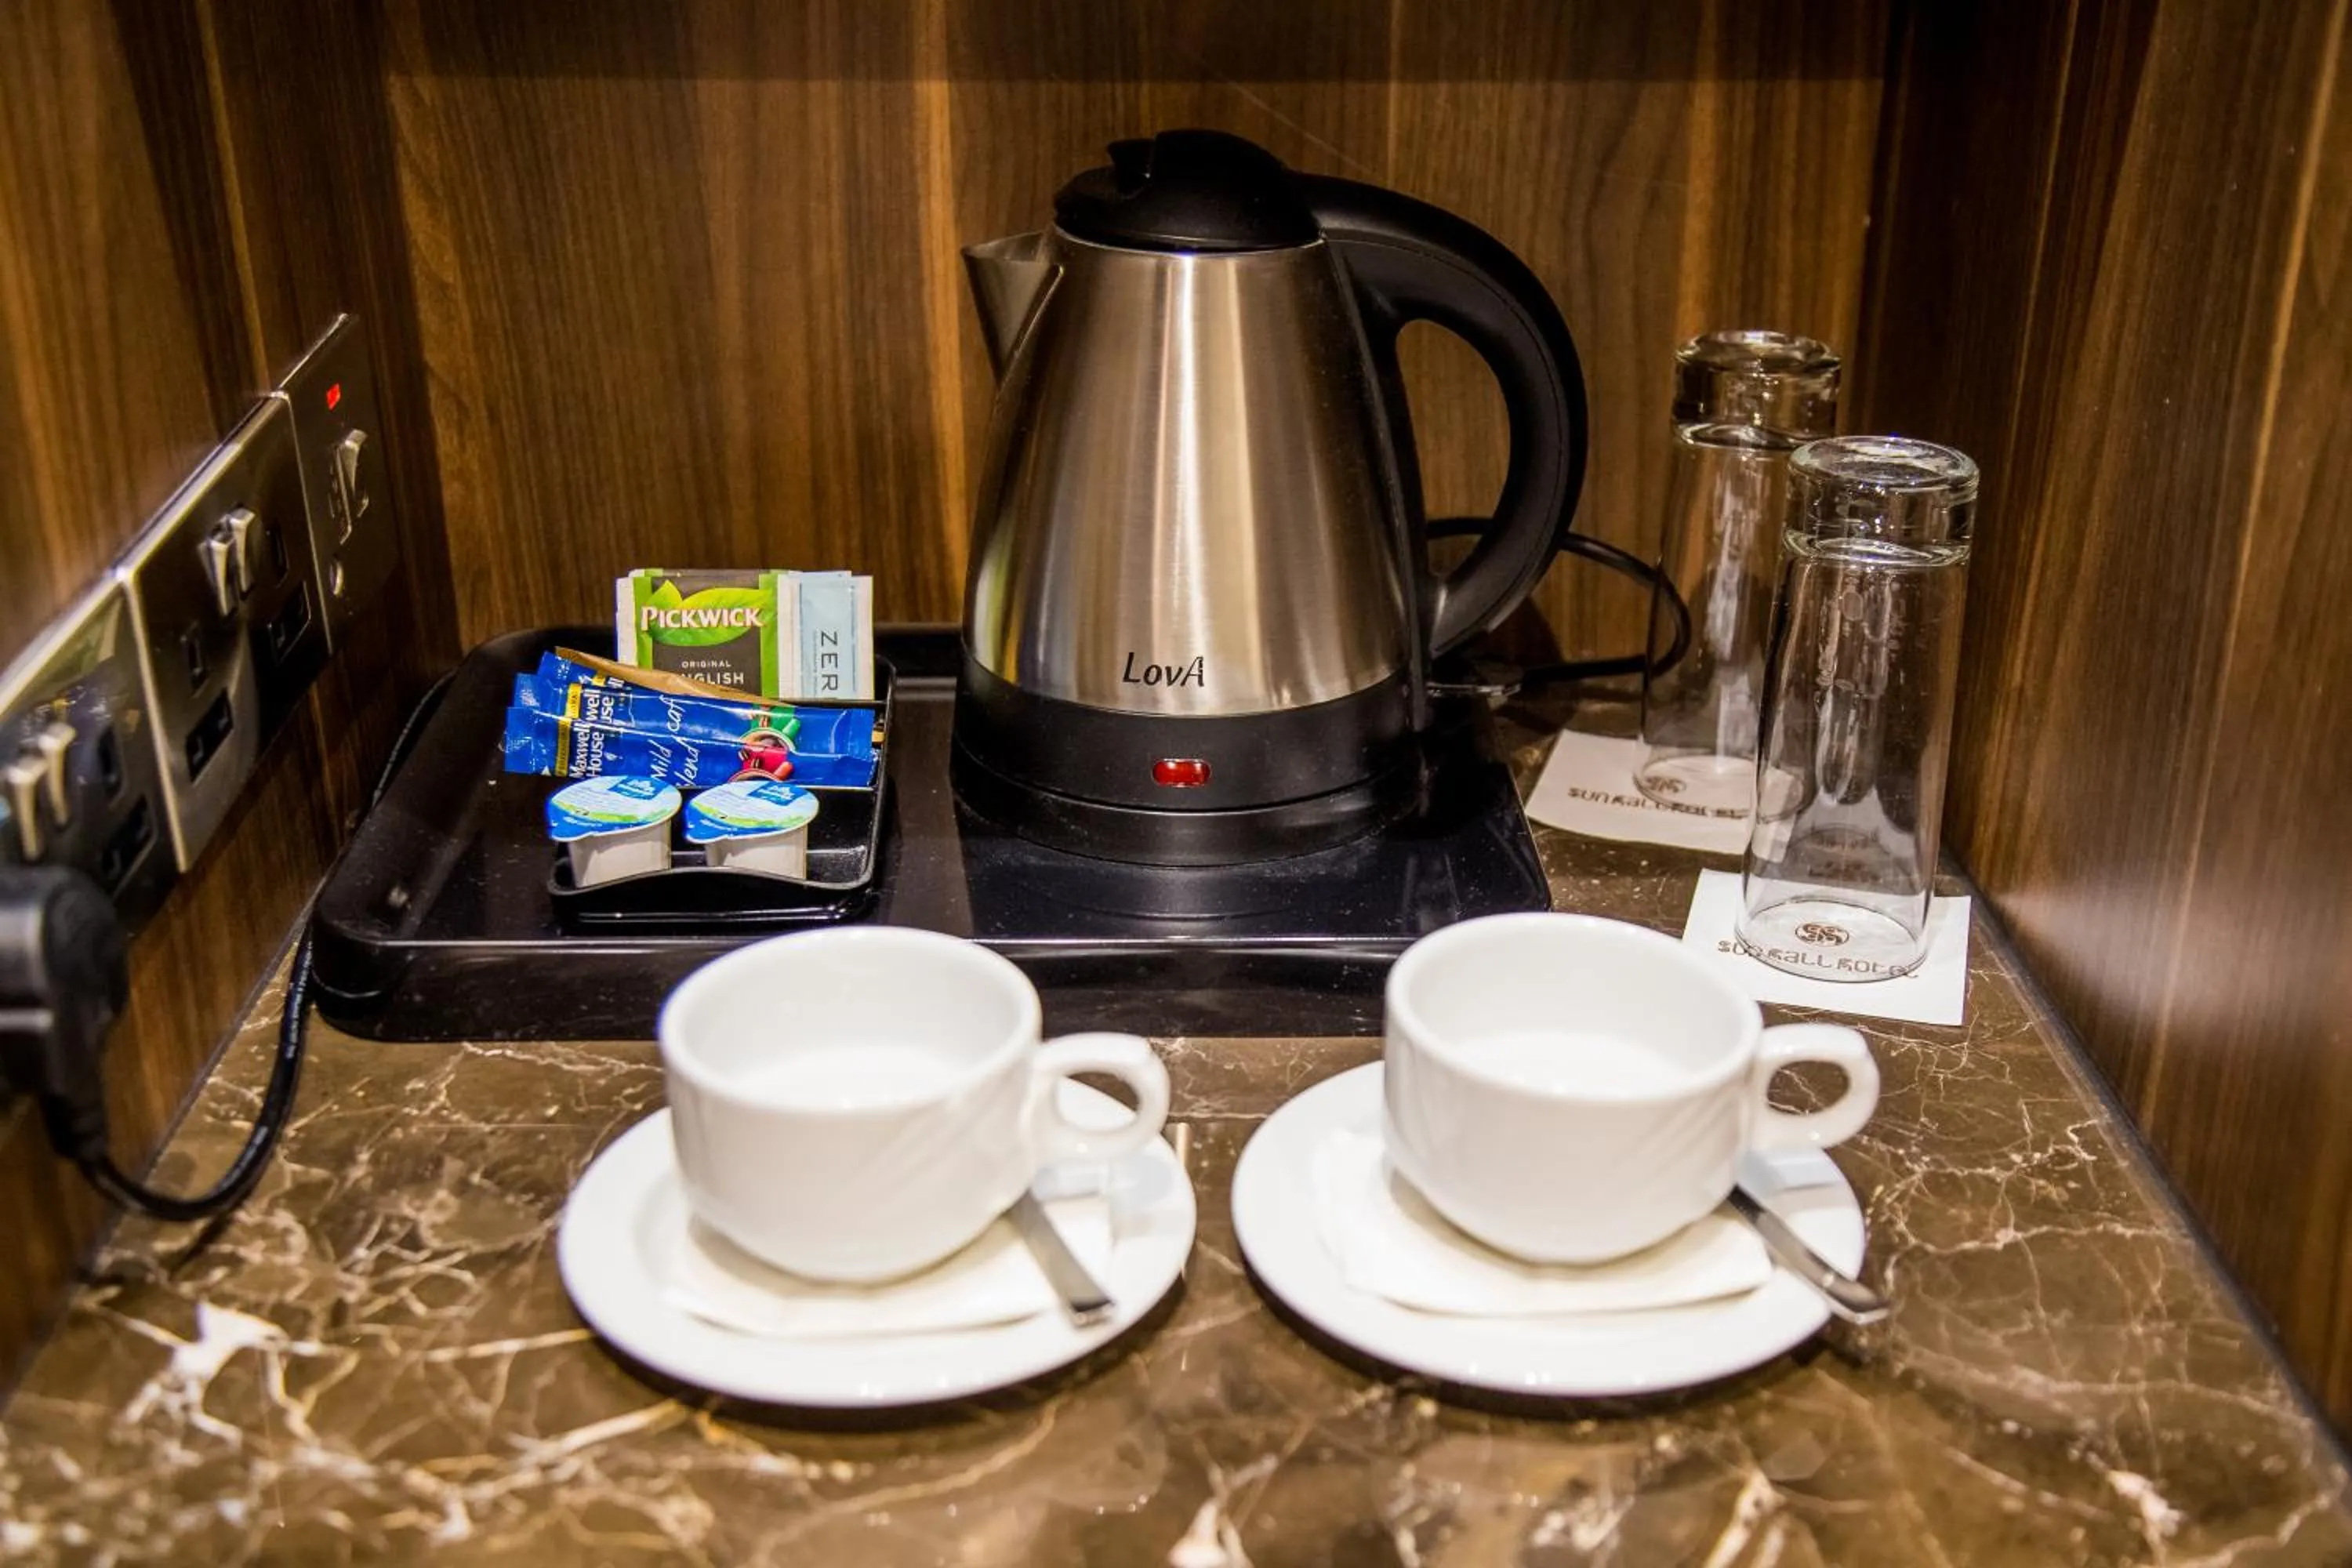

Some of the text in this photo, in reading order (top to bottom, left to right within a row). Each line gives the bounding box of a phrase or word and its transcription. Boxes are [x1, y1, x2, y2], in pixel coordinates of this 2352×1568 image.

[641, 606, 764, 630] PICKWICK
[681, 660, 731, 670] ORIGINAL
[681, 671, 744, 685] GLISH
[821, 630, 839, 699] ZER
[1123, 652, 1204, 687] LovA
[582, 689, 601, 721] well
[569, 722, 590, 778] Maxwell
[586, 731, 604, 778] House
[648, 739, 673, 779] Mild
[674, 734, 700, 786] lend
